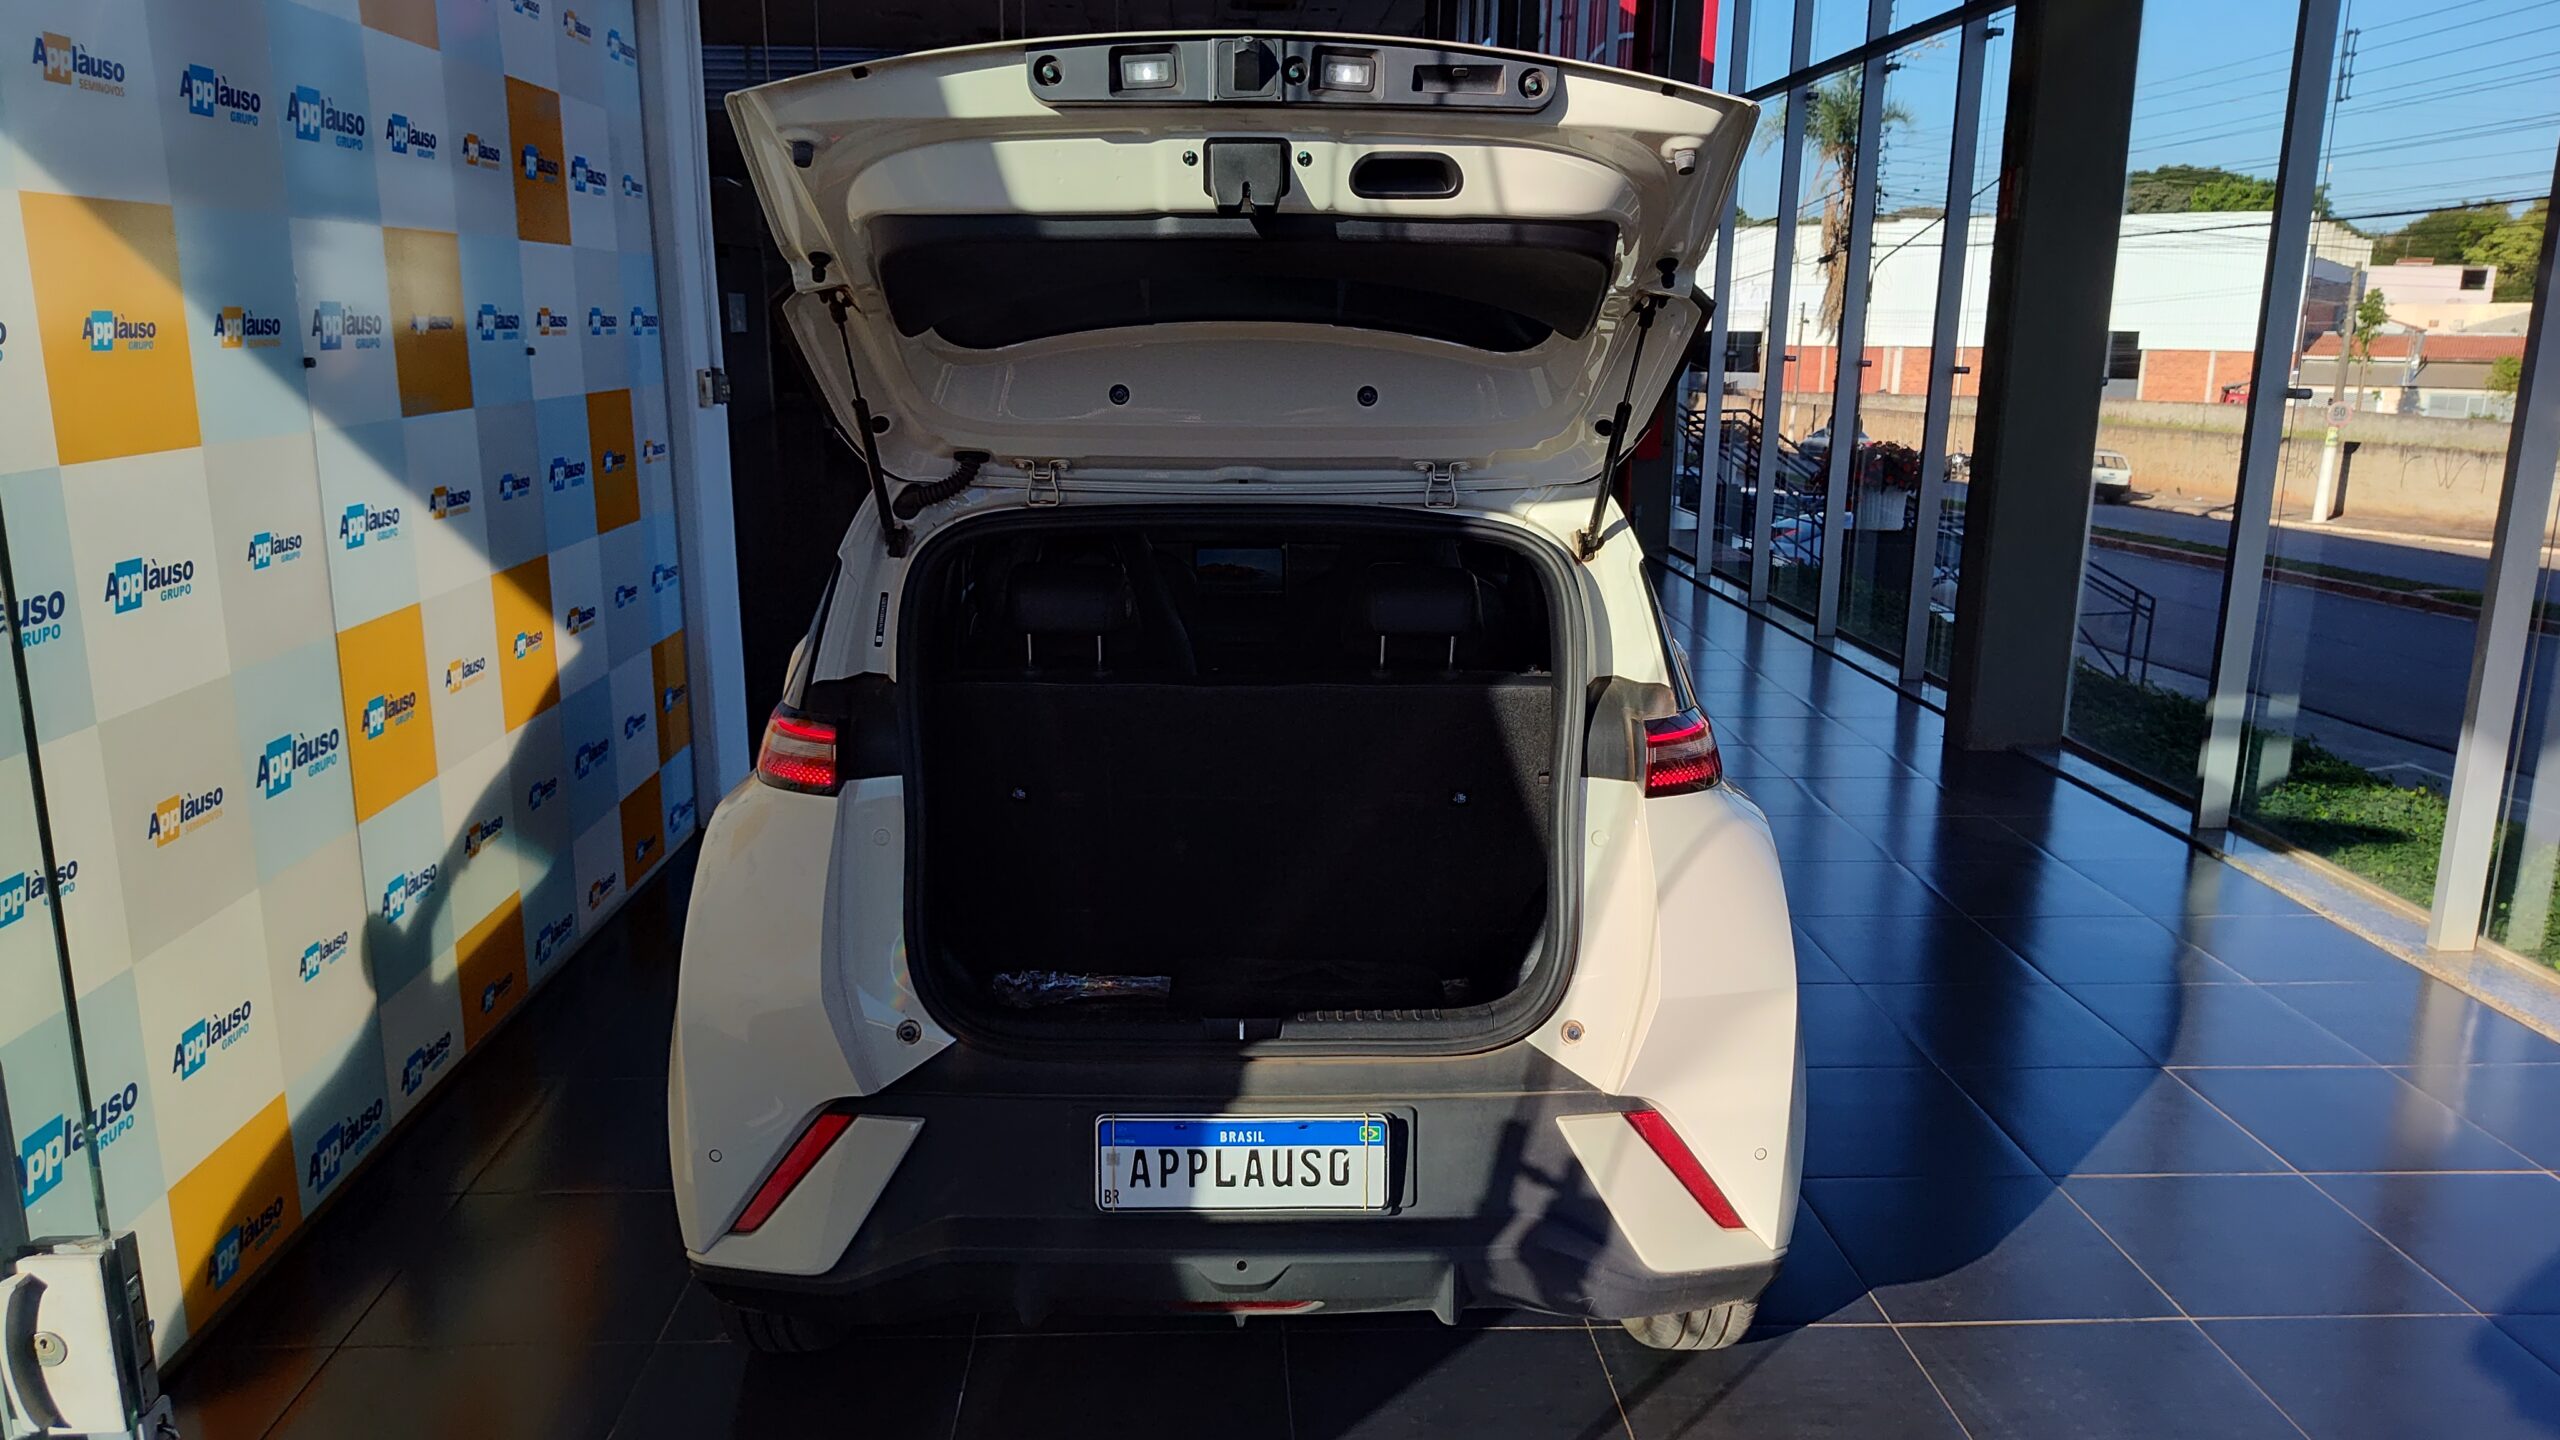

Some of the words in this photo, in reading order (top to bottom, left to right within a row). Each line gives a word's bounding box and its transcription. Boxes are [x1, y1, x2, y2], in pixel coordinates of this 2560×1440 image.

[32, 36, 125, 83] Applàuso
[79, 79, 125, 97] SEMINOVOS
[179, 68, 261, 114] Applàuso
[230, 111, 258, 126] GRUPO
[287, 89, 365, 137] Applàuso
[336, 136, 363, 151] GRUPO
[386, 117, 437, 150] Applàuso
[82, 313, 156, 346] Applàuso
[214, 309, 281, 344] Applàuso
[312, 305, 382, 343] Applàuso
[2334, 406, 2346, 417] 50
[340, 505, 400, 545] Applàuso
[248, 533, 302, 566] Applàuso
[104, 559, 194, 606] Applàuso
[160, 583, 192, 601] GRUPO
[21, 623, 61, 648] RUPO
[256, 728, 339, 789] Applàuso
[308, 753, 337, 777] GRUPO
[148, 786, 223, 840] Applàuso
[0, 860, 78, 921] pplàso
[172, 1000, 251, 1074] Applàuso
[222, 1023, 249, 1050] GRUPO
[97, 1114, 134, 1151] RUPO
[308, 1098, 383, 1188] Applàuso
[1219, 1130, 1265, 1144] BRASIL
[1104, 1189, 1120, 1205] BR
